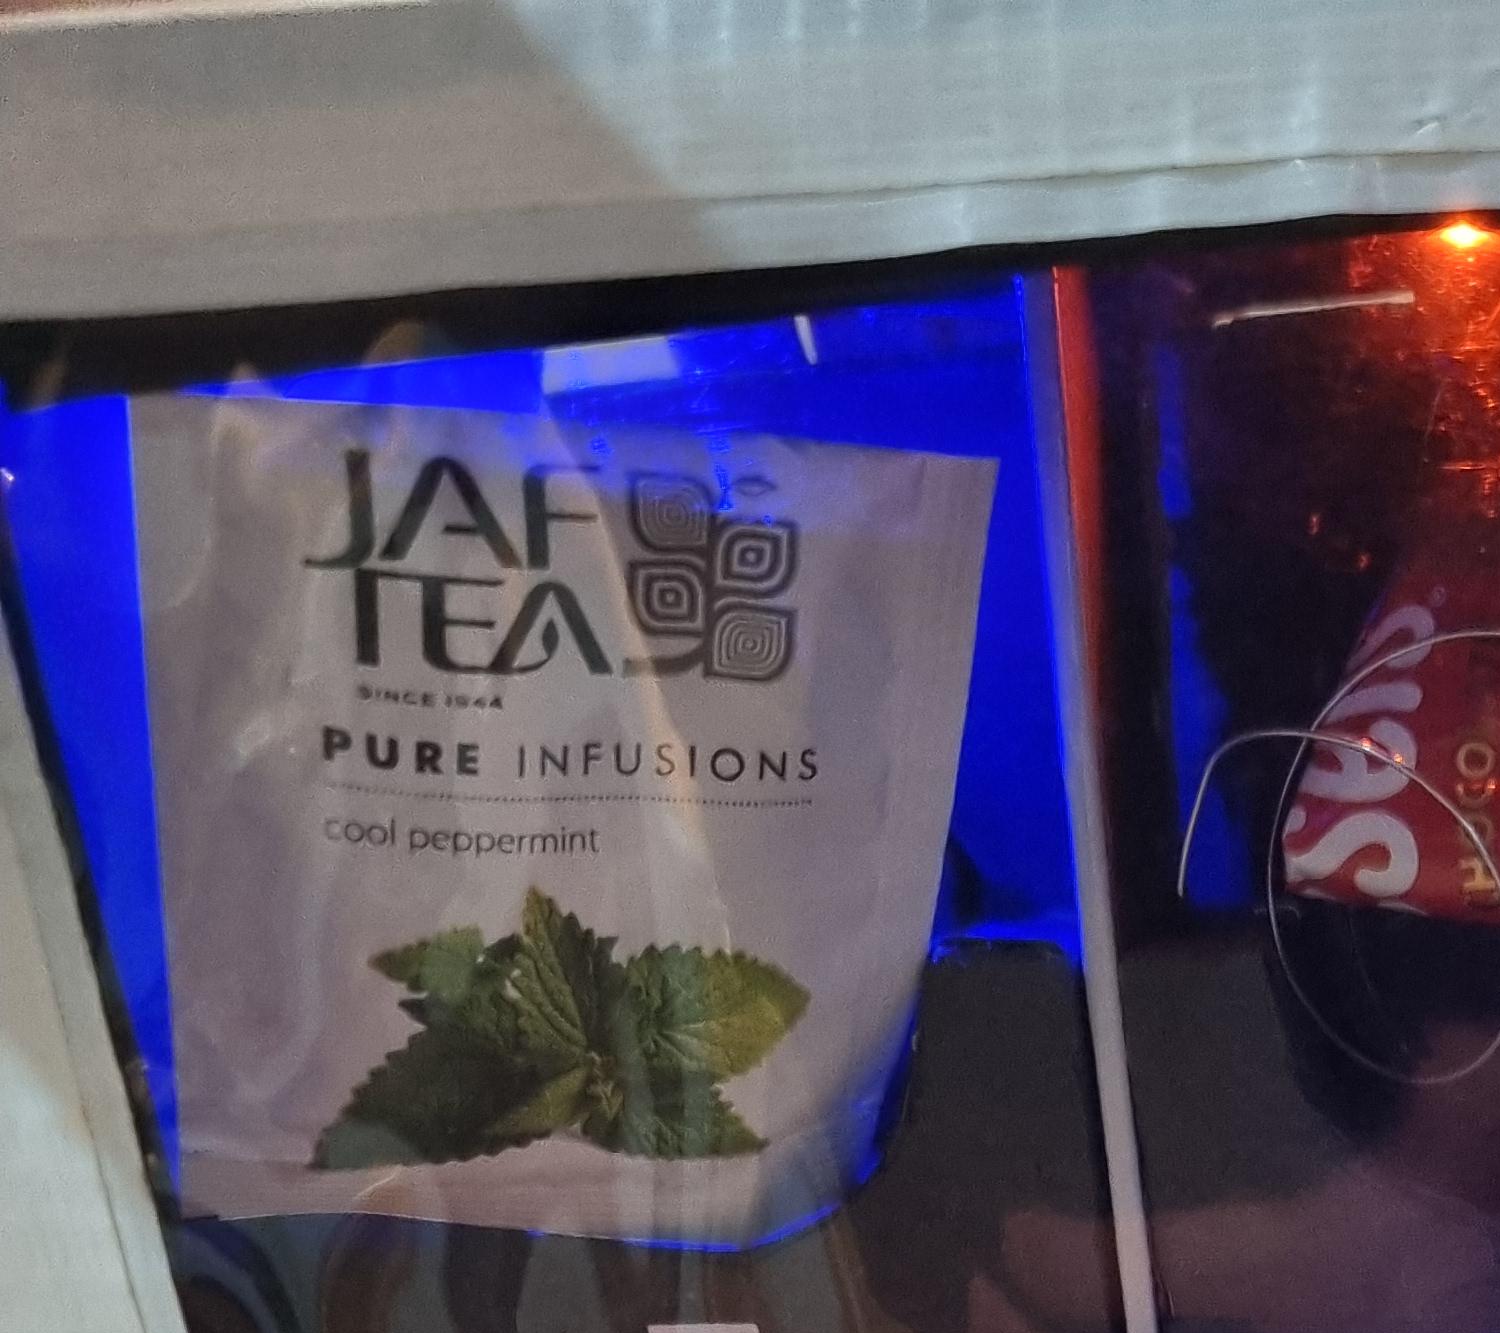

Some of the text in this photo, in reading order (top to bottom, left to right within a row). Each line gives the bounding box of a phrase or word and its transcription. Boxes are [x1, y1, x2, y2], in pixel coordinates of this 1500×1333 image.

[304, 446, 602, 570] JAF
[343, 566, 614, 677] TEA
[322, 725, 821, 784] PURE INFUSIONS
[323, 815, 602, 860] cool peppermint
